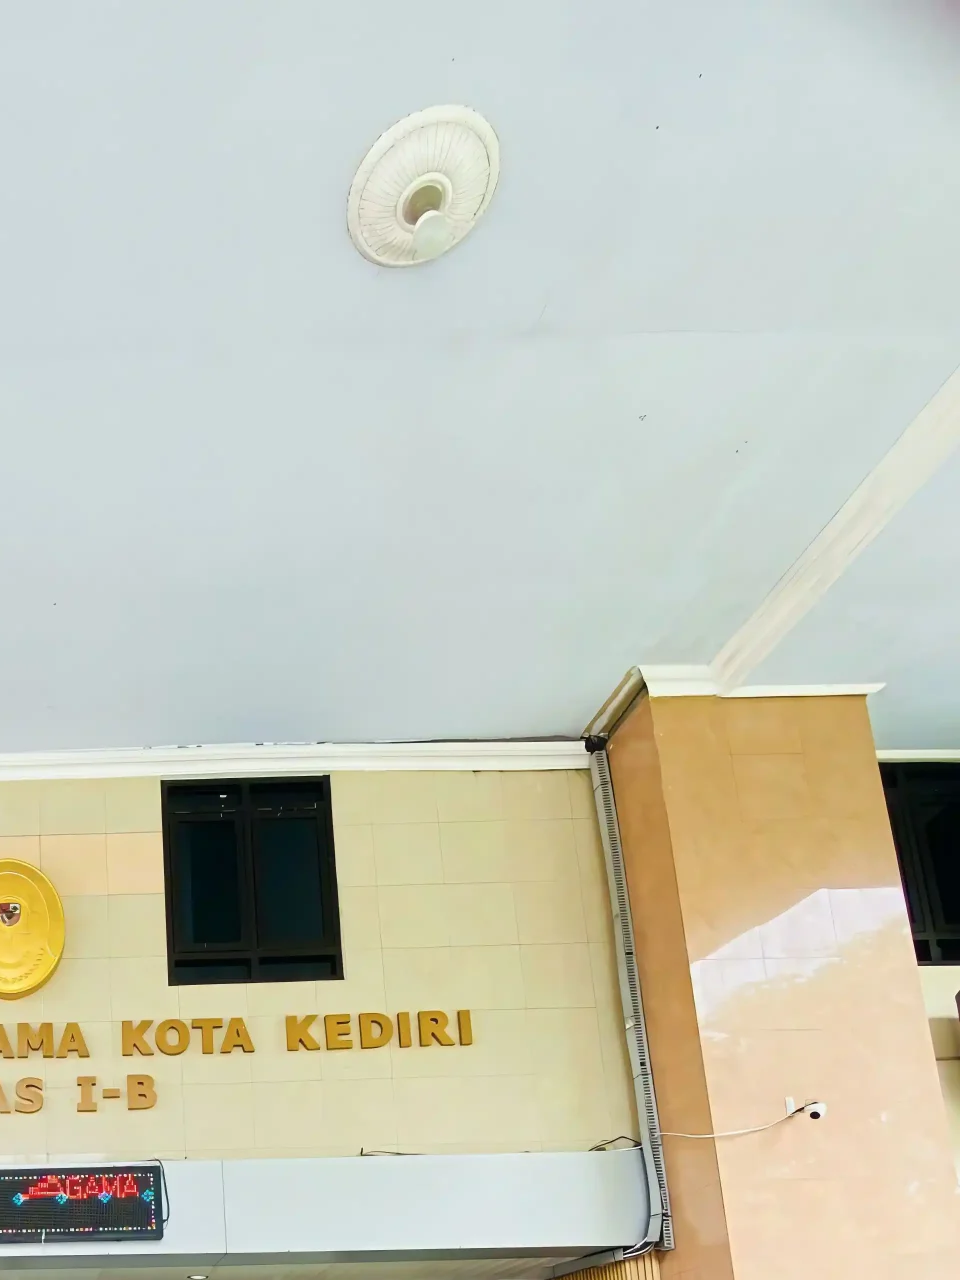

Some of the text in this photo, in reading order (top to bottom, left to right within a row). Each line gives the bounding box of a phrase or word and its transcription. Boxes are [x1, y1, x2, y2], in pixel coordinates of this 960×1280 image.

[121, 1017, 256, 1057] KOTA
[285, 1009, 473, 1052] KEDIRI
[76, 1074, 158, 1113] I-B
